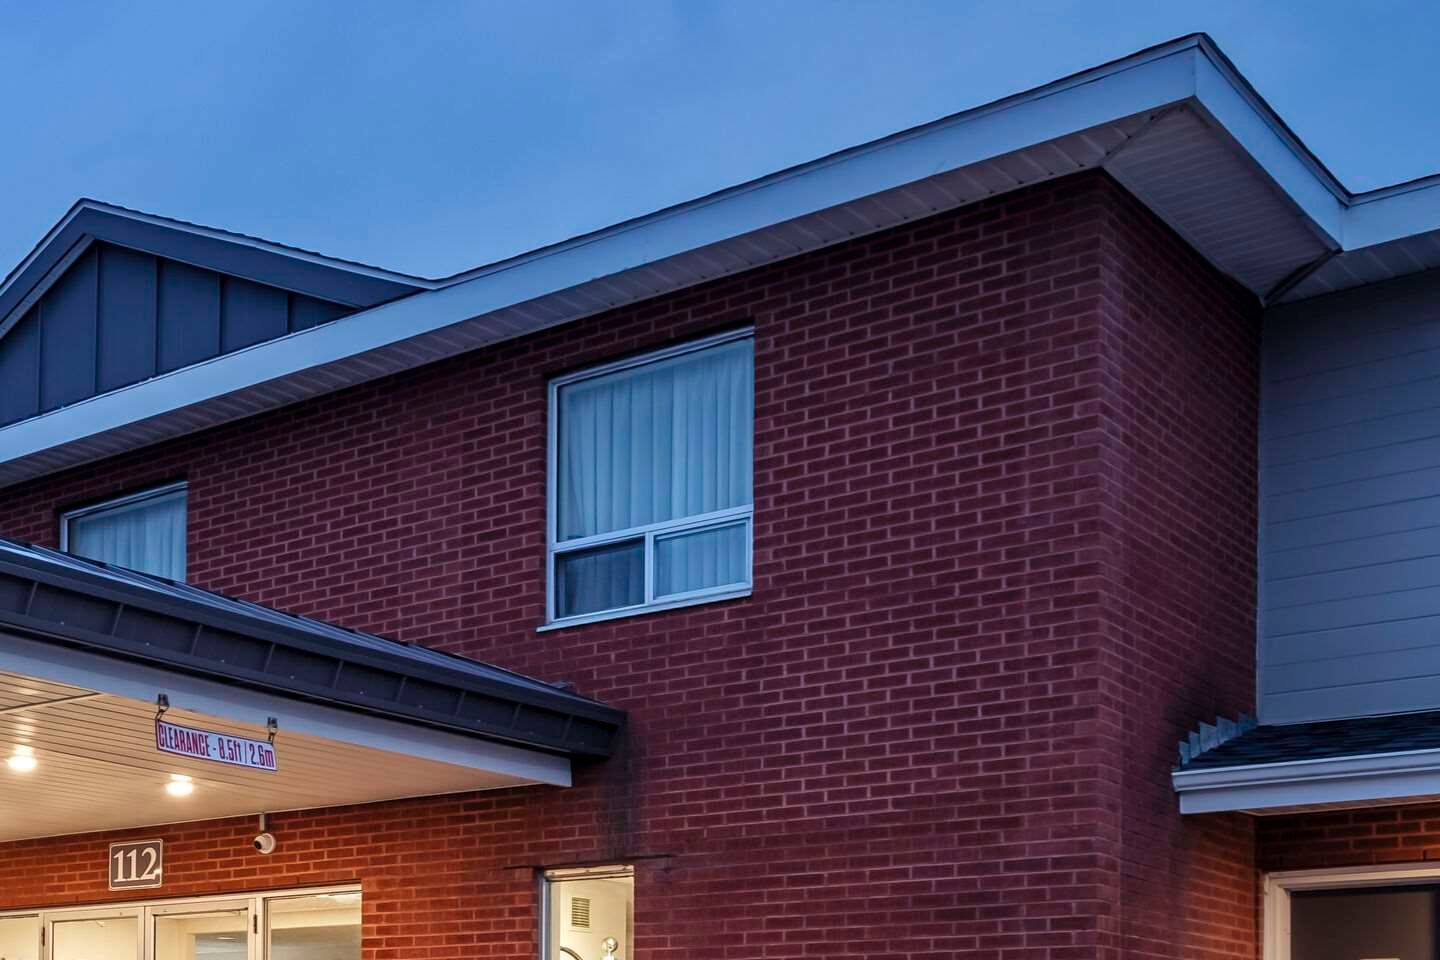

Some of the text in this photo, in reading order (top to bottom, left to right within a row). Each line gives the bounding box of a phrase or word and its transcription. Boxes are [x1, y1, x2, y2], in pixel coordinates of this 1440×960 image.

[158, 724, 210, 757] CLEARANCE
[249, 745, 275, 768] 2.6m
[113, 847, 160, 882] 112
